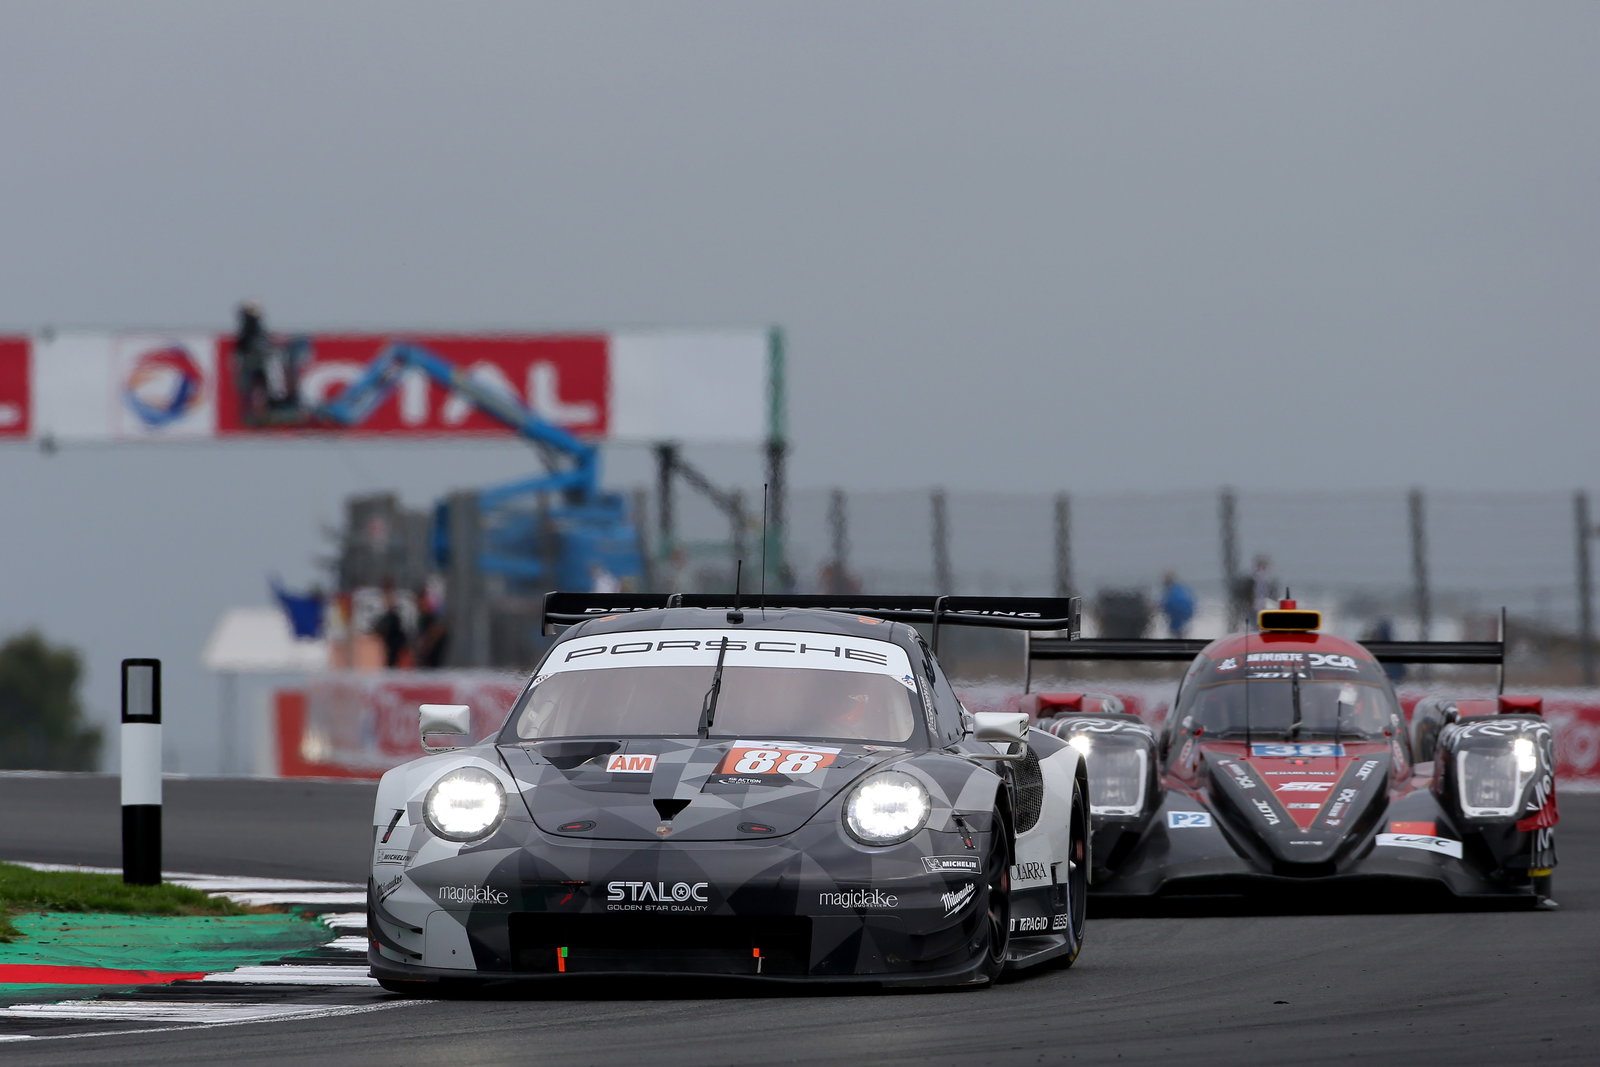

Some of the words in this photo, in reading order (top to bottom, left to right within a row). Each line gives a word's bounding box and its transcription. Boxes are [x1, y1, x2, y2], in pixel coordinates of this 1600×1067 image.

[564, 640, 887, 666] PORSCHE
[1264, 745, 1335, 756] 38
[609, 756, 653, 771] AM
[734, 750, 824, 774] 88
[1172, 813, 1207, 826] P2
[1251, 798, 1281, 826] JOTA
[383, 853, 412, 861] MICHELIN
[942, 860, 977, 868] MICHELIN
[439, 885, 509, 905] magiclake
[607, 881, 709, 902] STALOC
[819, 888, 899, 909] magiclake
[940, 882, 975, 912] Milwaukee
[644, 904, 669, 912] STAR
[1026, 916, 1048, 930] PAGID
